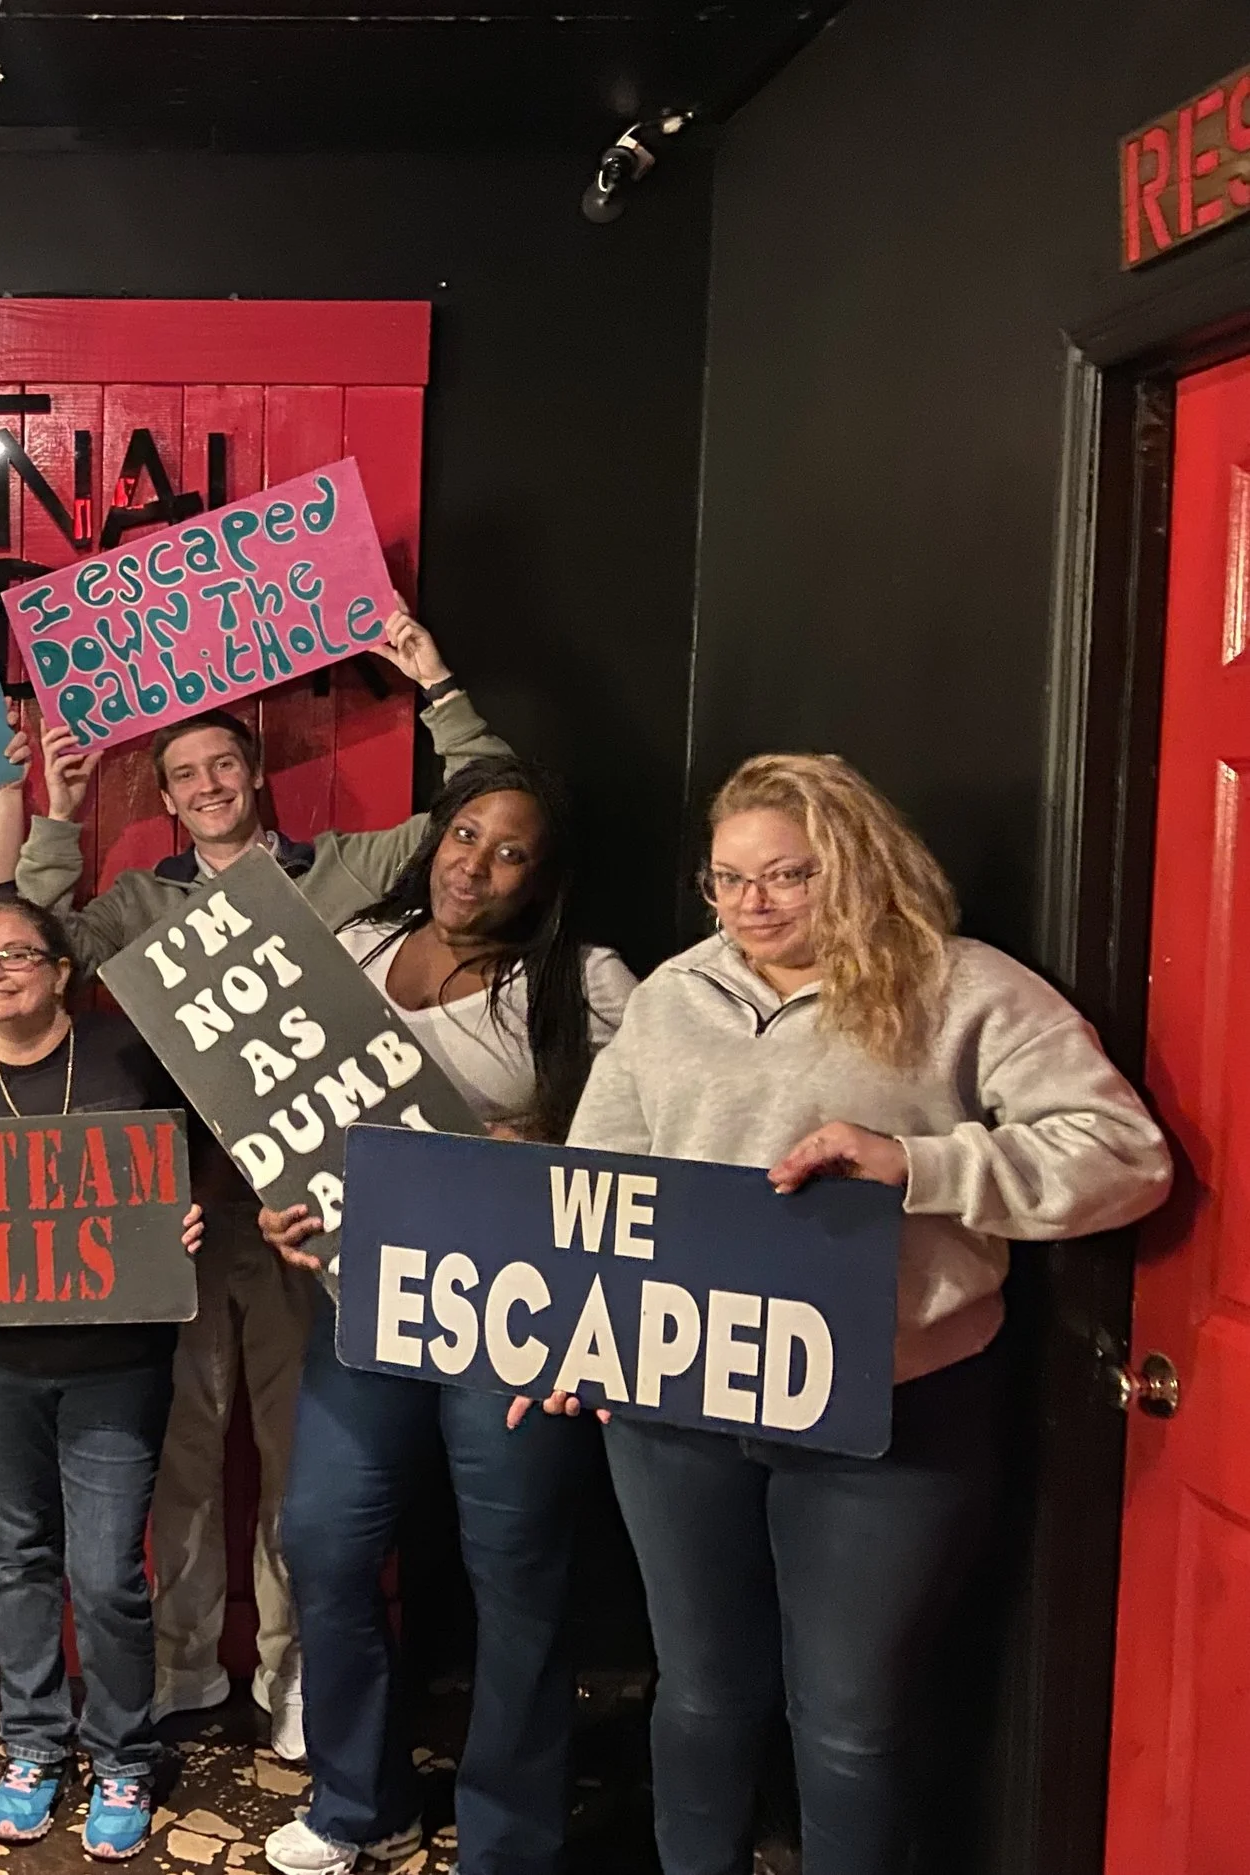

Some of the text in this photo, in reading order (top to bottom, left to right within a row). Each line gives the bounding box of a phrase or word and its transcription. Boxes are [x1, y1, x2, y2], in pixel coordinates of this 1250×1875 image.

[19, 586, 71, 634] I
[75, 474, 337, 608] escaped
[200, 560, 323, 632] The
[144, 890, 253, 989] I'M
[174, 934, 303, 1052] NOT
[239, 1005, 326, 1097] AS
[230, 1030, 422, 1190] DUMB
[550, 1165, 658, 1260] WE
[375, 1244, 834, 1432] ESCAPED
